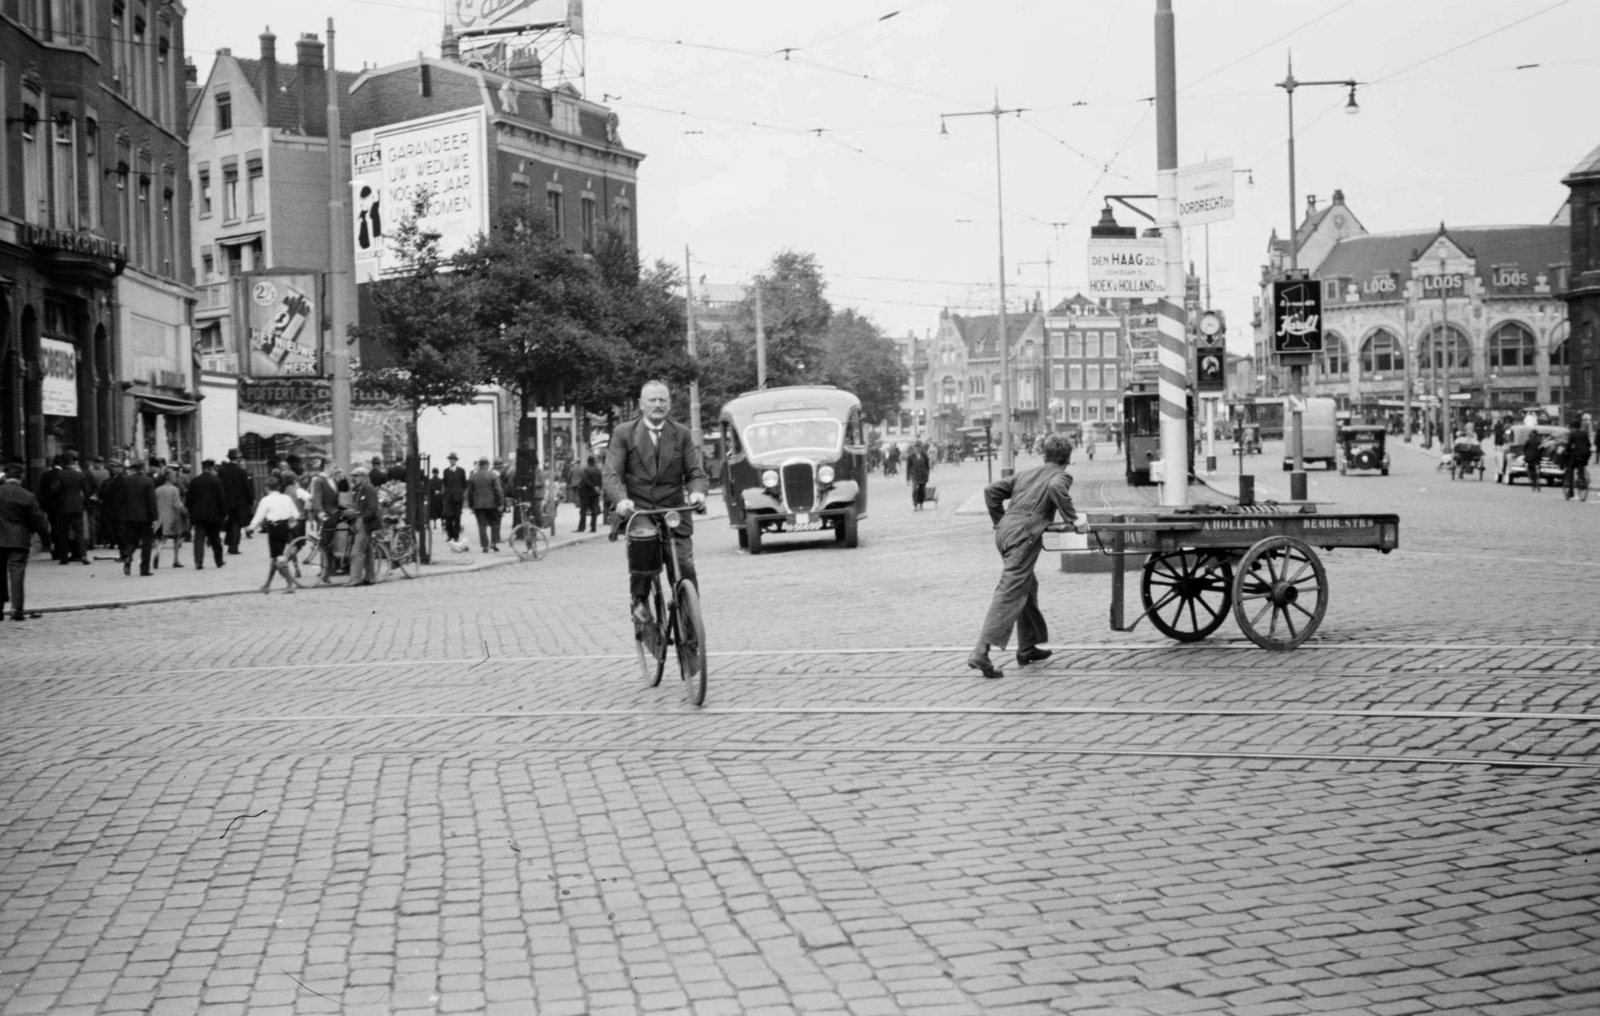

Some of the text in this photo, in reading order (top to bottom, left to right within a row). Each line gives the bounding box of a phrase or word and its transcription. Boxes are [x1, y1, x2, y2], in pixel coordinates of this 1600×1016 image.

[388, 132, 470, 163] GARANDEER
[389, 166, 408, 182] UW
[416, 153, 470, 176] WEDUWE
[390, 184, 412, 202] NOG
[443, 174, 470, 194] JAAR
[1180, 195, 1224, 216] DORDRECHT
[1092, 256, 1109, 266] DEN
[1112, 253, 1143, 266] HAAG
[1090, 279, 1112, 292] HOEK
[1119, 279, 1155, 292] HOLLAND
[1363, 278, 1397, 294] LOOS
[1424, 275, 1463, 290] LOOS
[1492, 272, 1529, 287] LOOS
[252, 328, 317, 360] HET NIEUWE
[283, 362, 317, 375] MERK
[247, 387, 315, 401] POFFERTJES
[1213, 519, 1274, 530] HOLLEMAN
